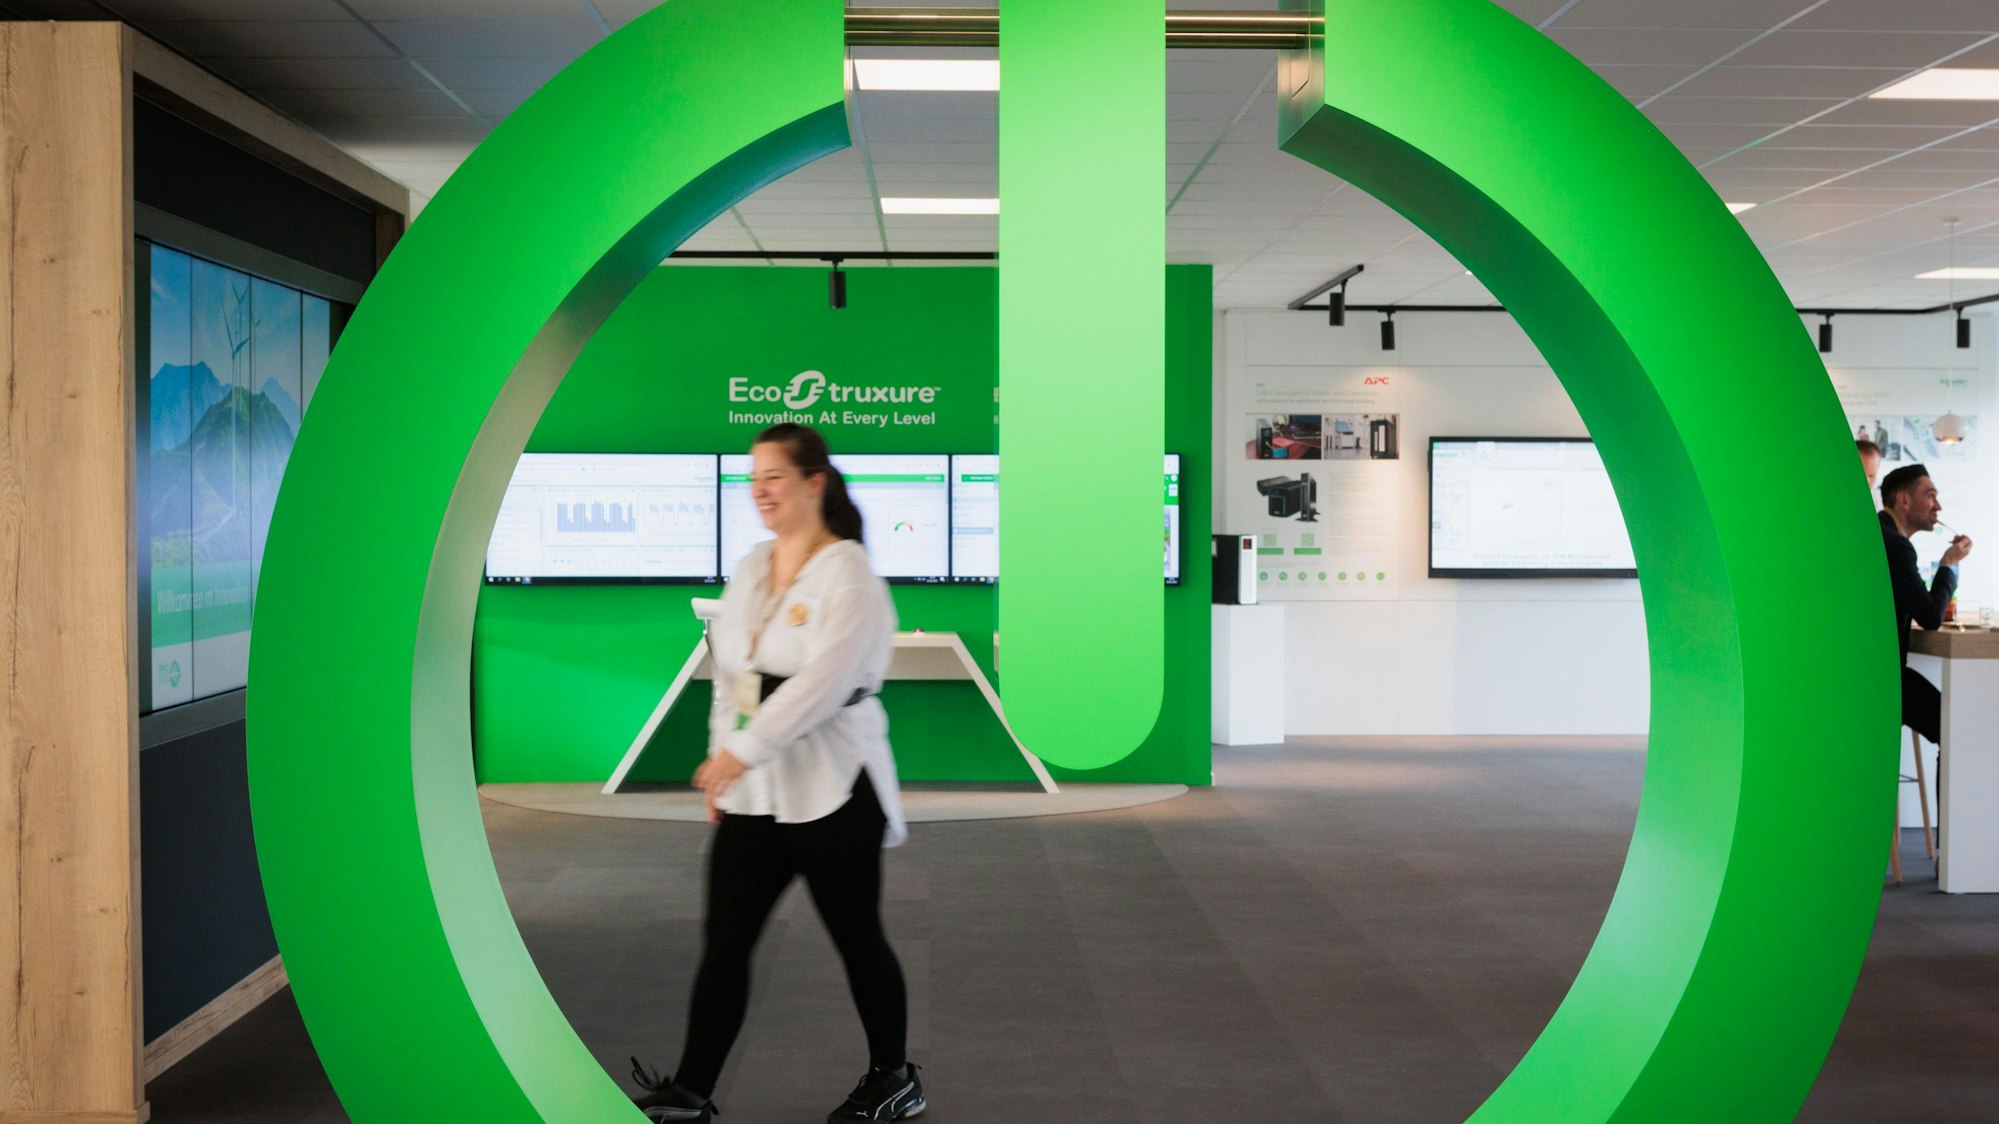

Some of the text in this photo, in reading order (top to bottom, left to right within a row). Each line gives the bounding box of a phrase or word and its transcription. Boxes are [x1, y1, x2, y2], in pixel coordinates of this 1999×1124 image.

[1364, 377, 1389, 385] APC
[729, 411, 935, 428] Innovation At Every Level
